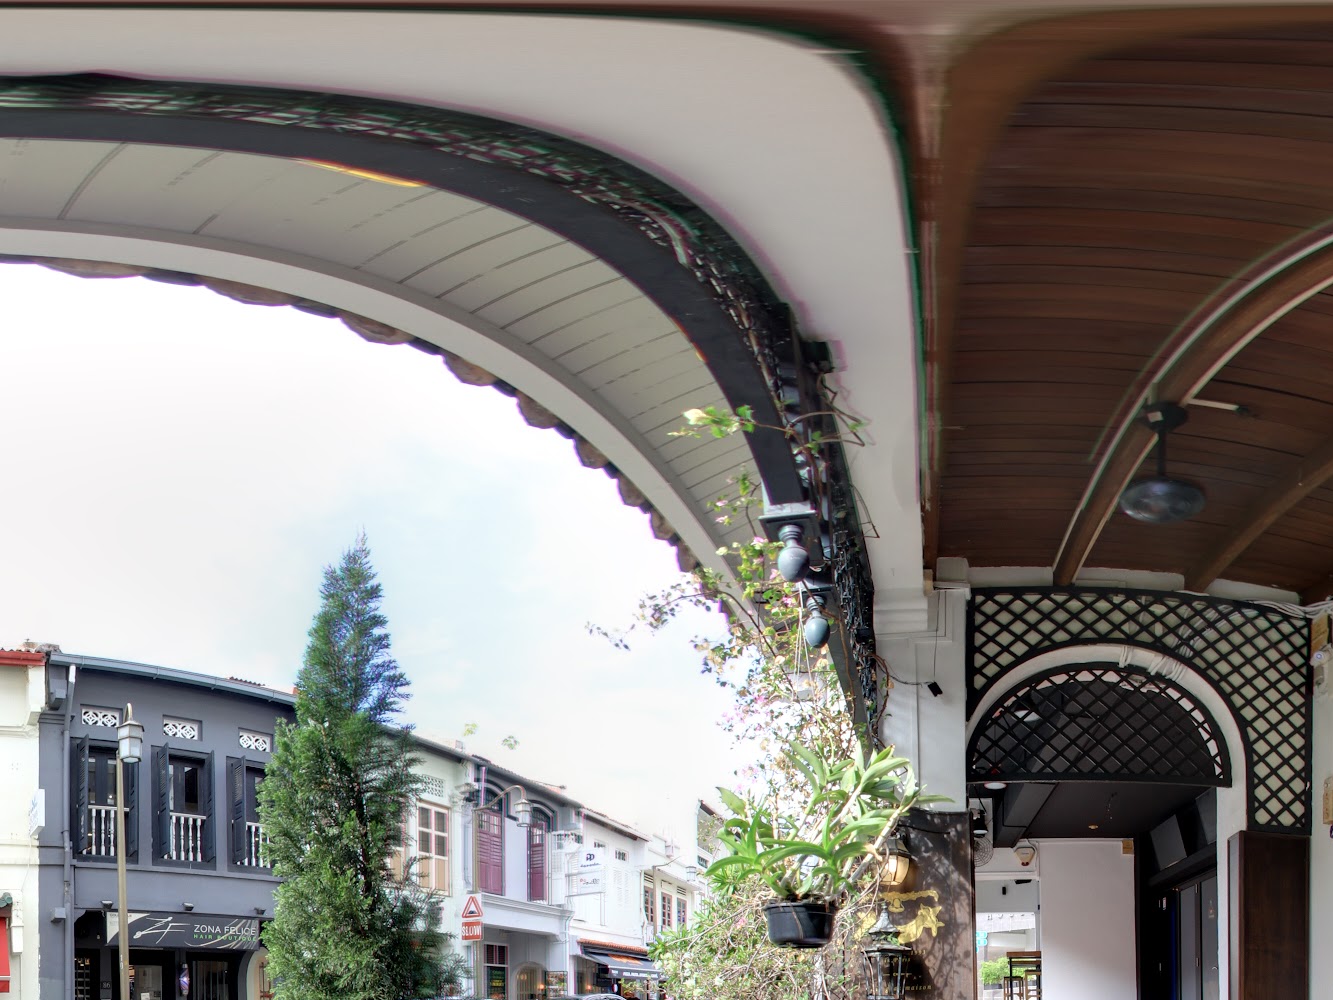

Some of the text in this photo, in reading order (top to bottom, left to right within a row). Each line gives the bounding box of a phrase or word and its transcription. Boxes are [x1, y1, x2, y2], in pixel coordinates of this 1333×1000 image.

[193, 924, 256, 936] ZONA FELICE
[102, 981, 111, 989] 86
